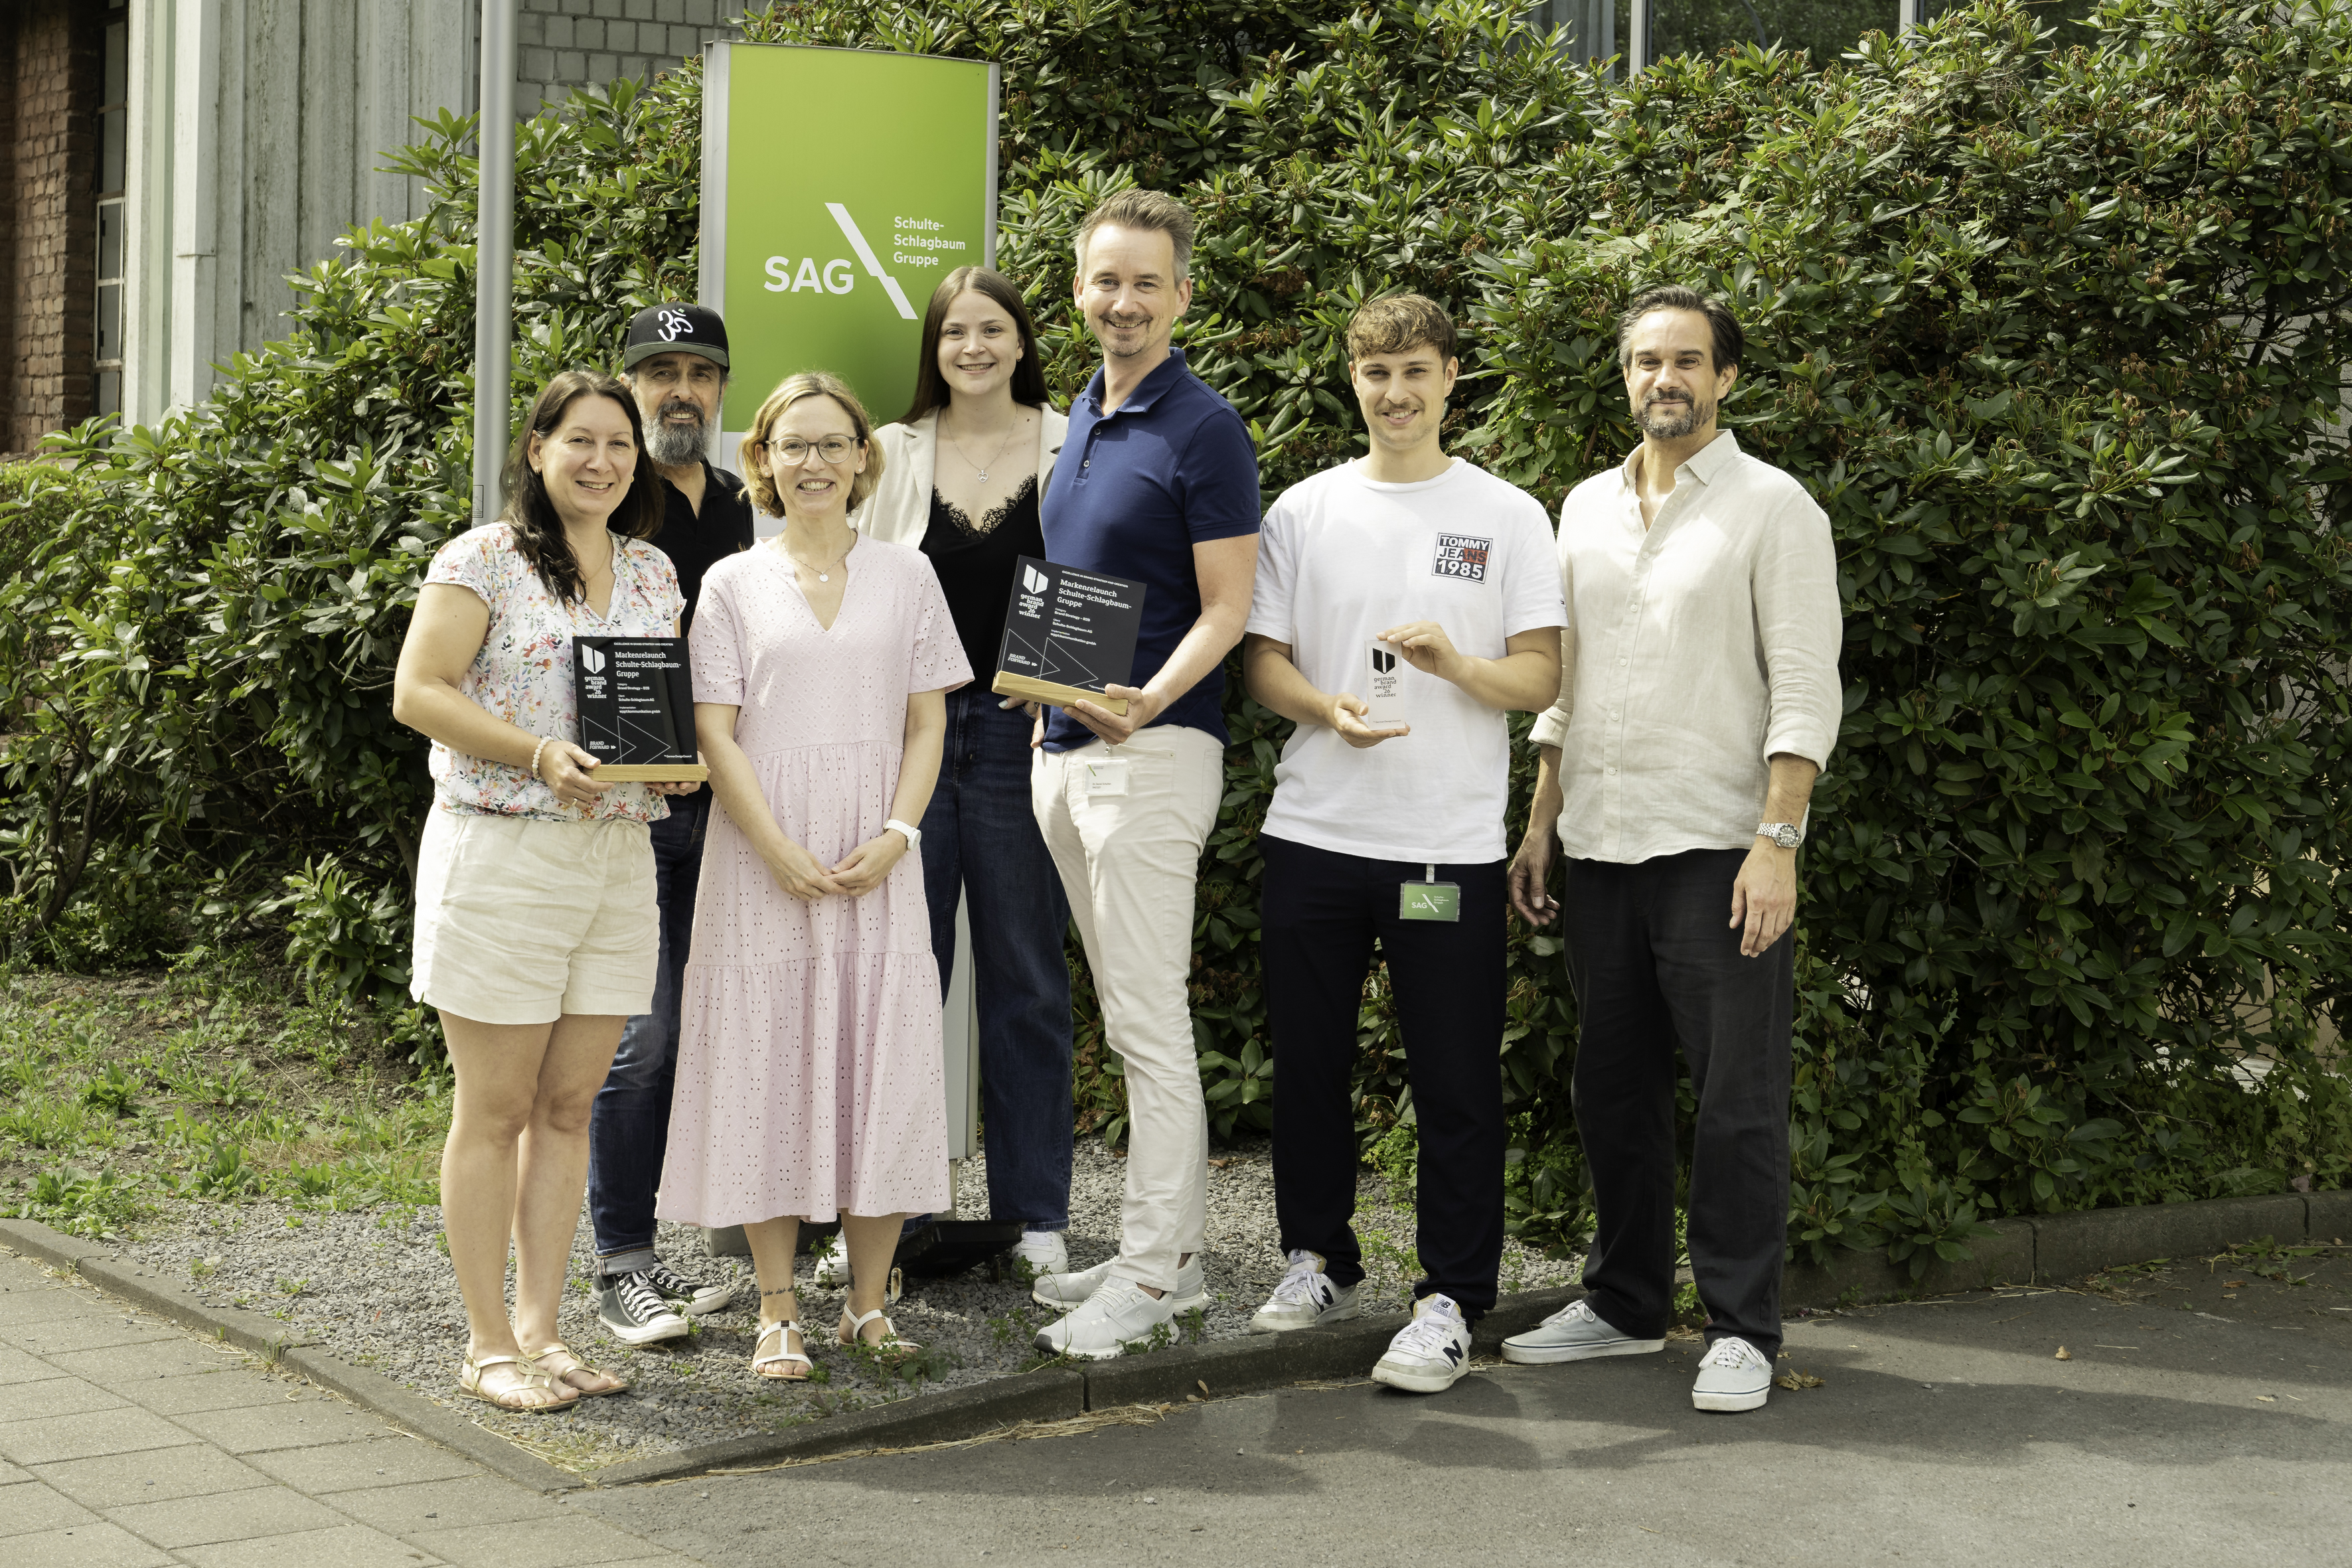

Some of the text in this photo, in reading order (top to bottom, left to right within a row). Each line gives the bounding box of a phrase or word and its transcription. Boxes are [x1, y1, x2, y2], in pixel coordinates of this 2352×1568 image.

[894, 216, 944, 231] Schulte-
[894, 234, 965, 250] Schlagbaum
[894, 252, 939, 268] Gruppe
[763, 256, 854, 295] SAG
[1441, 536, 1488, 550] TOMMY
[1439, 548, 1486, 562] JEANS
[1438, 560, 1482, 579] 1985
[1060, 579, 1117, 597] Markenrelaunch
[1057, 597, 1082, 607] Gruppe
[1059, 588, 1132, 609] Schulte-Schlagbaum-
[1443, 1338, 1464, 1368] N
